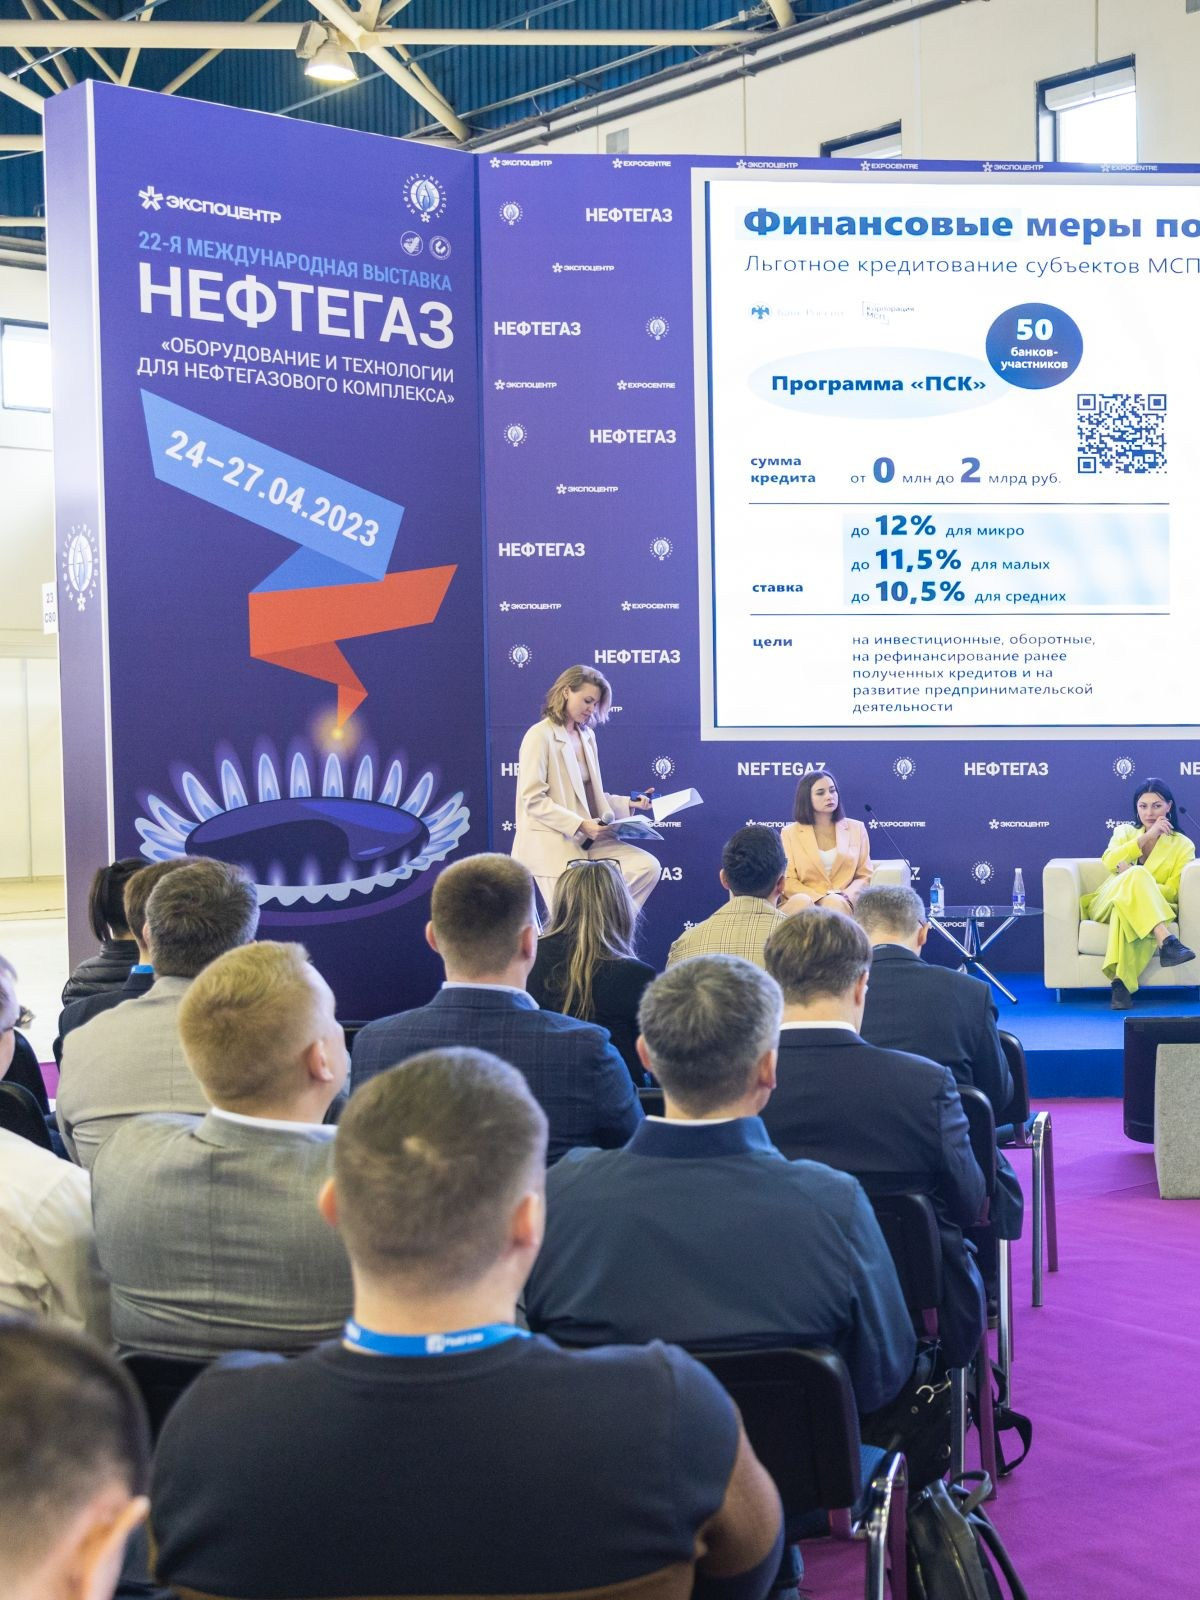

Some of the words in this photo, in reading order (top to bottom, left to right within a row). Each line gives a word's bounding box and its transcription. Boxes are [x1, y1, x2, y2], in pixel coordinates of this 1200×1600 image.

[501, 159, 553, 167] ЭКСПОЦЕНТР
[748, 161, 799, 169] ЭКСПОЦЕНТР
[994, 163, 1044, 171] ЭКСПОЦЕНТР
[166, 195, 281, 223] ЭКСПОЦЕНТР
[585, 207, 673, 223] НЕФТЕГАЗ
[743, 207, 1014, 237] Финансовые
[1026, 217, 1142, 246] меры
[138, 231, 182, 253] 22-Я
[187, 238, 358, 278] МЕЖДУНАРОДНАЯ
[363, 263, 452, 292] ВЫСТАВКА
[744, 255, 850, 272] Льготное
[858, 260, 1018, 277] кредитование
[1025, 256, 1140, 278] субъектов
[1148, 257, 1200, 274] МСП
[139, 262, 454, 349] НЕФТЕГАЗ
[493, 320, 582, 336] НЕФТЕГАЗ
[1016, 318, 1054, 341] 50
[161, 337, 320, 368] «ОБОРУДОВАНИЕ
[325, 354, 337, 370] И
[342, 356, 454, 383] ТЕХНОЛОГИИ
[1010, 346, 1059, 358] банков-
[1000, 360, 1069, 371] участников
[137, 357, 179, 377] ДЛЯ
[184, 361, 338, 393] НЕФТЕГАЗОВОГО
[343, 379, 454, 404] КОМПЛЕКСА»
[506, 381, 558, 389] ЭКСПОЦЕНТР
[771, 375, 904, 395] Программа
[910, 375, 987, 392] «ПСК»
[589, 428, 677, 444] НЕФТЕГАЗ
[750, 457, 802, 469] сумма
[850, 475, 867, 484] от
[872, 456, 896, 484] 0
[902, 475, 932, 484] млн
[935, 475, 955, 486] до
[960, 456, 981, 484] 2
[988, 475, 1028, 487] млрд
[1031, 472, 1062, 487] руб.
[750, 474, 816, 486] кредита
[850, 527, 870, 539] до
[875, 514, 937, 536] 12%
[945, 527, 972, 539] для
[976, 527, 1025, 539] микро
[498, 542, 586, 557] НЕФТЕГАЗ
[850, 561, 870, 573] до
[875, 548, 962, 573] 11,5%
[970, 561, 998, 572] для
[1002, 561, 1050, 570] малых
[751, 584, 804, 593] ставка
[850, 593, 870, 604] до
[875, 580, 966, 605] 10,5%
[974, 593, 1001, 604] для
[1005, 592, 1066, 605] средних
[752, 638, 793, 649] цели
[852, 636, 869, 645] на
[874, 636, 1004, 647] инвестиционные,
[1009, 632, 1096, 648] оборотные,
[594, 649, 681, 664] НЕФТЕГАЗ
[852, 653, 870, 662] на
[874, 650, 1020, 665] рефинансирование
[1024, 652, 1068, 665] ранее
[852, 670, 944, 682] полученных
[949, 669, 1018, 681] кредитов
[1022, 669, 1031, 678] и
[1036, 669, 1053, 678] на
[853, 687, 920, 699] развитие
[925, 683, 1093, 699] предпринимательской
[852, 703, 953, 715] деятельности
[964, 761, 1049, 777] НЕФТЕГАЗ
